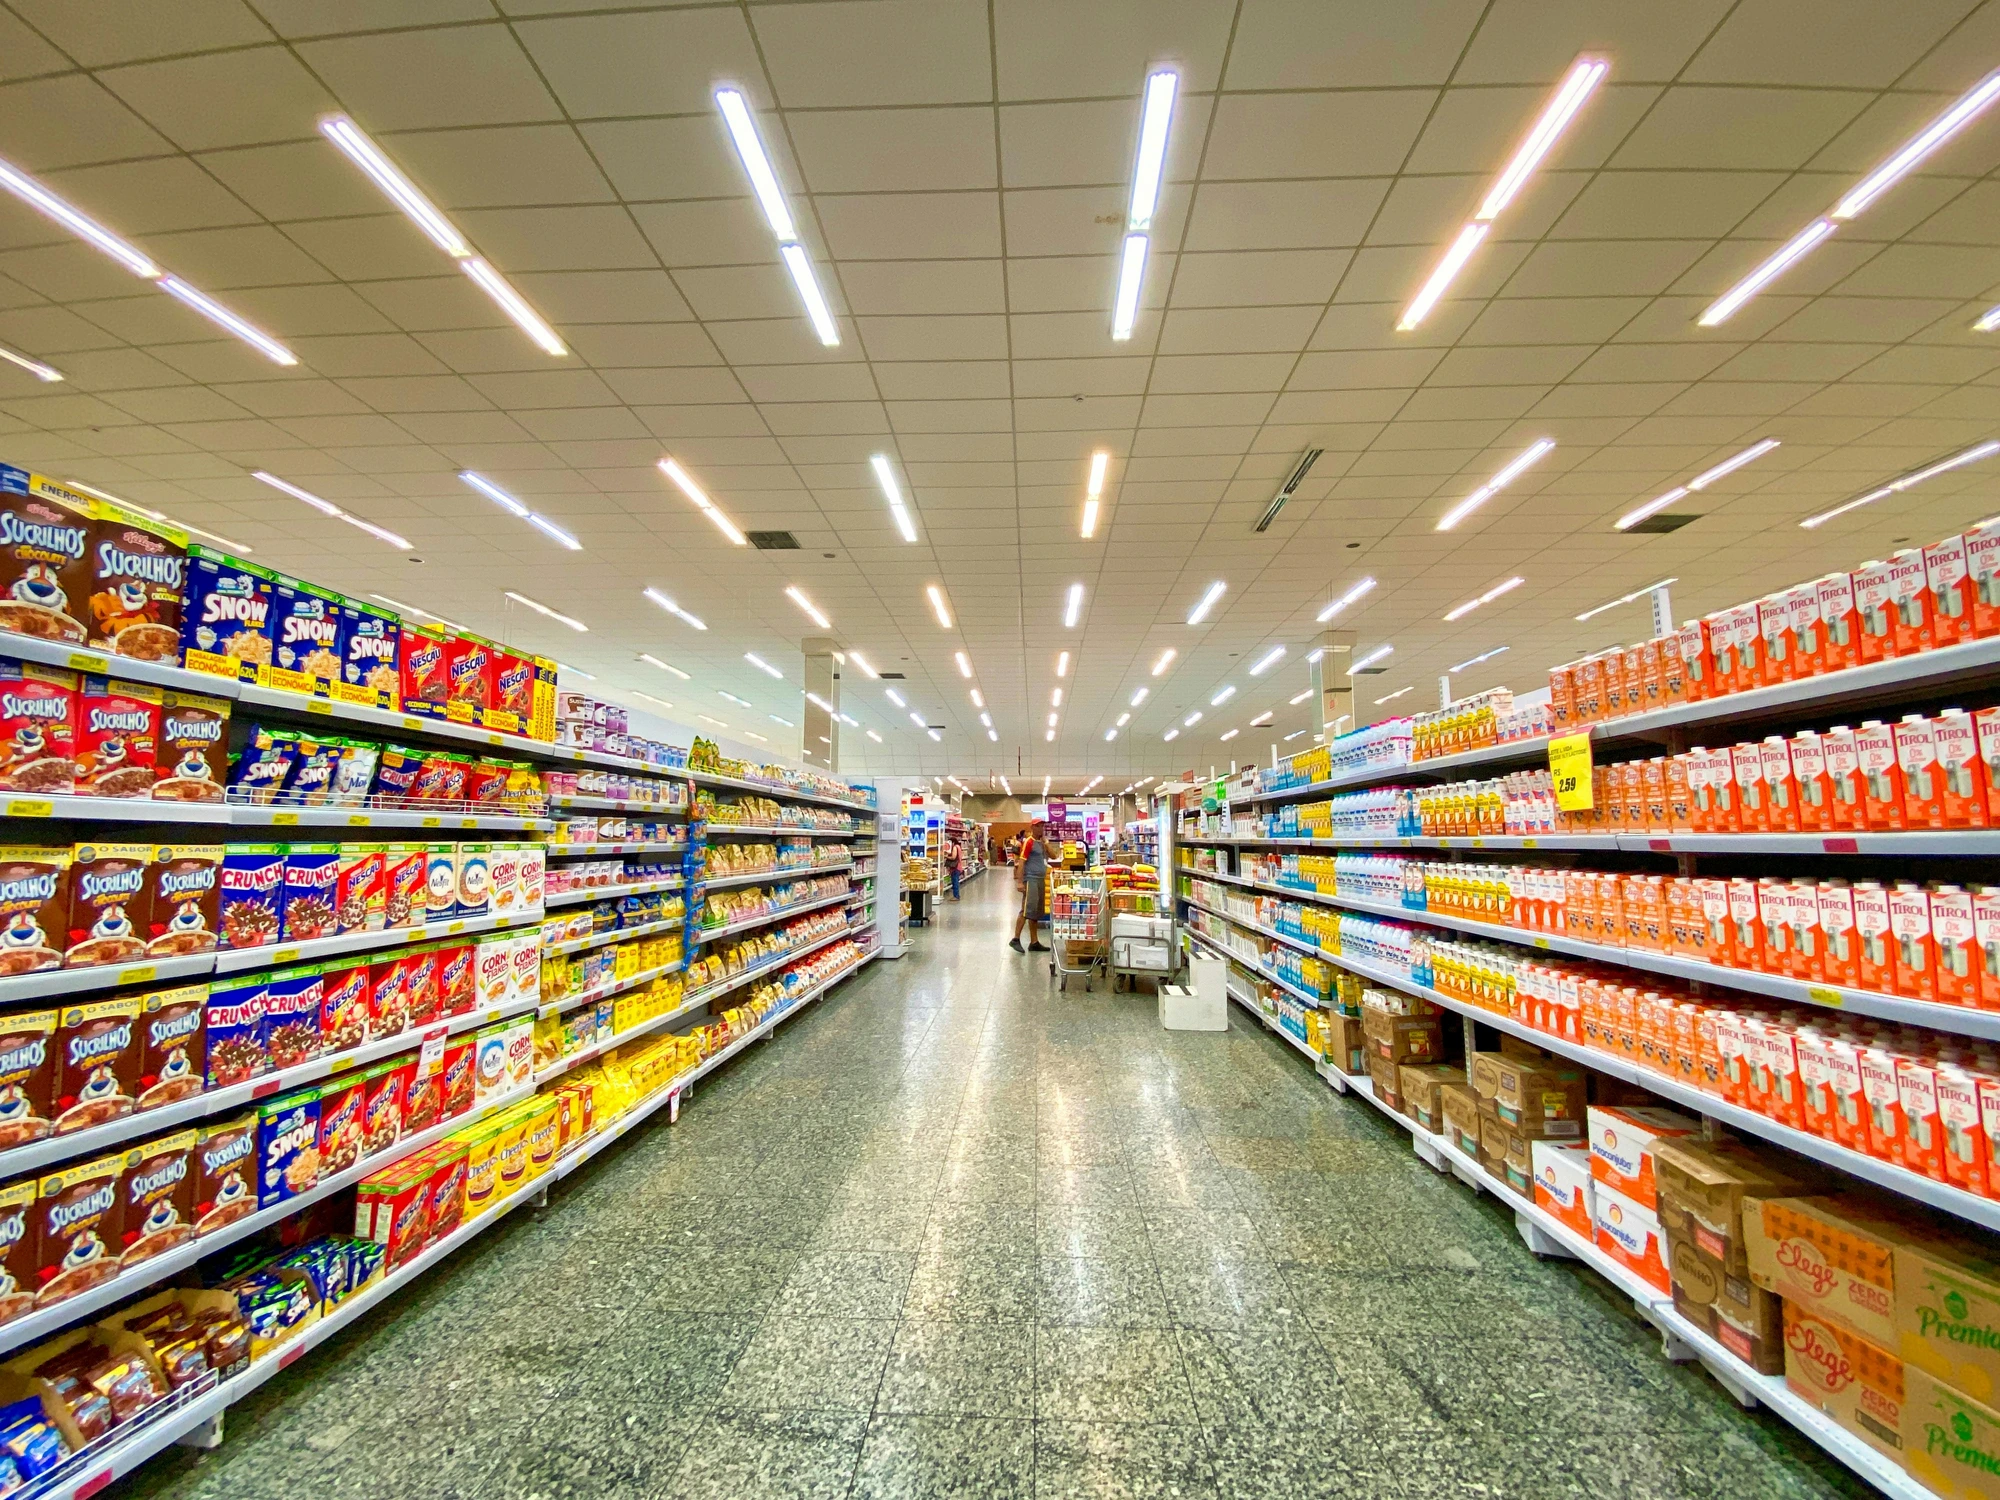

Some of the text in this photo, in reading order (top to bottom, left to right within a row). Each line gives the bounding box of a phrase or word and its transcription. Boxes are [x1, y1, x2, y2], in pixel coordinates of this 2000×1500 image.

[41, 482, 90, 507] ENERGIA
[0, 512, 87, 560] SUCRILHOS
[98, 542, 183, 589] SUCRILHOS
[1927, 550, 1963, 568] TIROL
[1889, 563, 1923, 580] TIROL
[1820, 586, 1850, 601] TIROL
[1855, 575, 1888, 592] TIROL
[202, 593, 268, 622] SNOW
[1761, 606, 1787, 620] TIROL
[1789, 597, 1817, 612] TIROL
[283, 616, 337, 643] SNOW
[1711, 623, 1732, 636] TIROL
[1733, 616, 1756, 630] TIROL
[350, 635, 395, 660] SNOW
[1680, 631, 1701, 645] TIROL
[189, 651, 226, 663] EMBALAGEM
[409, 647, 441, 672] NESCAU
[451, 653, 486, 680] NESCAU
[188, 660, 237, 677] ECONÔMICA
[272, 669, 304, 681] EMBALAGEM
[116, 683, 156, 696] ENERGIA
[272, 675, 313, 692] ECONÔMICA
[499, 667, 530, 692] NESCAU
[2, 694, 68, 720] SUCRILHOS
[341, 690, 376, 705] ECONÔMICA
[90, 708, 150, 733] SUCRILHOS
[538, 683, 546, 740] ECONÔMICA
[548, 686, 556, 742] ECONÔMICA
[166, 718, 222, 741] SUCRILHOS
[1935, 728, 1971, 742] TIROL
[1825, 743, 1854, 755] TIROL
[1857, 739, 1891, 752] TIROL
[1897, 734, 1932, 746] TIROL
[1707, 758, 1730, 768] TIROL
[1734, 755, 1759, 765] TIROL
[1762, 752, 1787, 762] TIROL
[1792, 747, 1822, 759] TIROL
[244, 762, 292, 781] SNOW
[416, 768, 446, 791] NESCAU
[477, 775, 506, 796] NESCAU
[222, 863, 283, 888] CRUNCH
[286, 862, 339, 886] CRUNCH
[348, 860, 381, 890] NESCAU
[394, 859, 423, 886] NESCAU
[492, 861, 516, 880] CORN
[522, 861, 542, 879] CORN
[81, 867, 144, 900] SUCRILHOS
[160, 867, 216, 897] SUCRILHOS
[1704, 891, 1725, 902] TIROL
[1730, 892, 1755, 902] TIROL
[1761, 894, 1786, 905] TIROL
[1787, 896, 1816, 908] TIROL
[1821, 898, 1850, 911] TIROL
[1857, 900, 1886, 913] TIROL
[1892, 903, 1927, 916] TIROL
[1932, 905, 1971, 920] TIROL
[482, 951, 506, 973] CORN
[513, 946, 536, 966] CORN
[442, 951, 471, 984] NESCAU
[175, 986, 208, 997] SABOR
[325, 974, 366, 1018] NESCAU
[374, 969, 407, 1005] NESCAU
[100, 999, 141, 1011] SABOR
[268, 984, 323, 1013] CRUNCH
[7, 1013, 56, 1026] SABOR
[208, 993, 268, 1026] CRUNCH
[151, 1008, 201, 1048] SUCRILHOS
[1717, 1025, 1741, 1040] TIROL
[69, 1023, 132, 1066] SUCRILHOS
[509, 1034, 531, 1059] CORN
[1741, 1033, 1766, 1049] TIROL
[1766, 1040, 1791, 1057] TIROL
[1798, 1049, 1825, 1066] TIROL
[1827, 1057, 1858, 1075] TIROL
[445, 1048, 474, 1088] NESCAU
[1862, 1066, 1895, 1084] TIROL
[1899, 1074, 1933, 1095] TIROL
[366, 1076, 399, 1123] NESCAU
[1938, 1085, 1976, 1106] TIROL
[322, 1093, 362, 1143] NESCAU
[157, 1132, 195, 1149] SABOR
[267, 1120, 318, 1167] SNOW
[204, 1132, 253, 1176] SUCRILHOS
[1592, 1143, 1632, 1170] Piracanjuba
[80, 1157, 123, 1174] SABOR
[131, 1155, 188, 1204] SUCRILHOS
[433, 1161, 466, 1211] NESCAU
[1535, 1174, 1568, 1200] Piracanjuba
[49, 1182, 116, 1236] SUCRILHOS
[395, 1183, 431, 1236] NESCAU
[1849, 1278, 1889, 1306] ZERO
